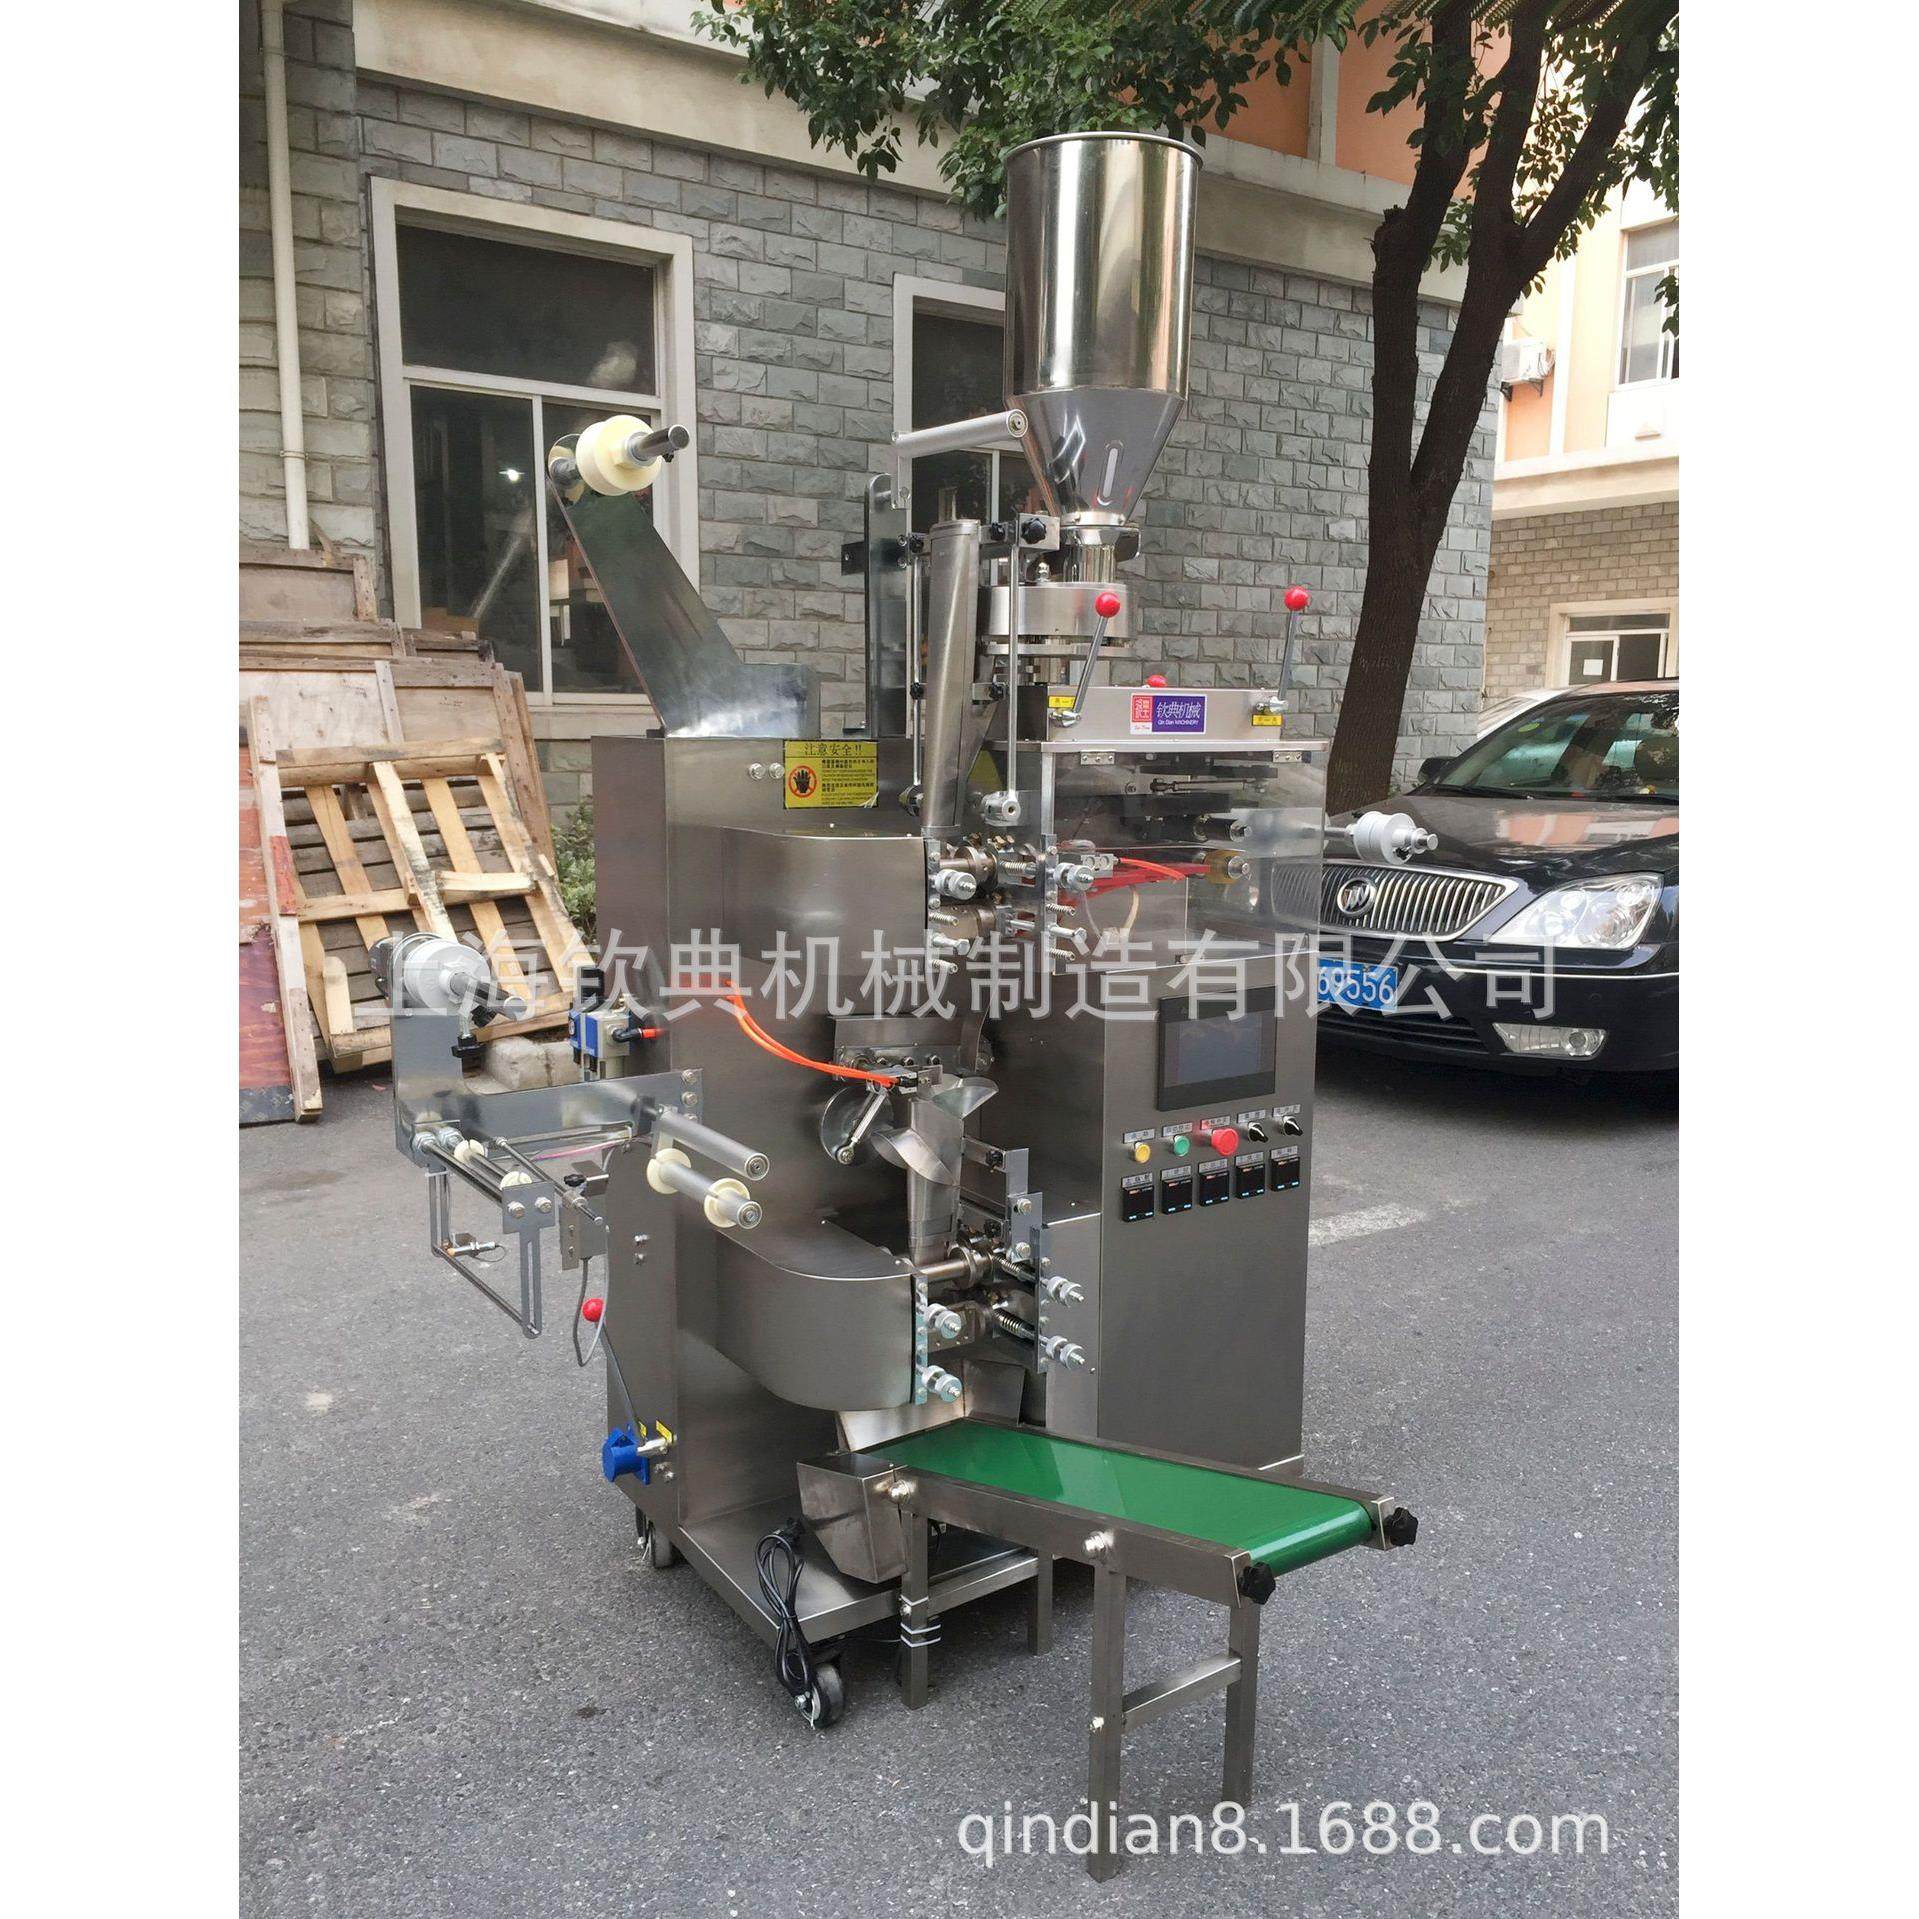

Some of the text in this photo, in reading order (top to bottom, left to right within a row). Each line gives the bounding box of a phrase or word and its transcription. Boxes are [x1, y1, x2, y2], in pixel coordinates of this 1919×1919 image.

[1157, 701, 1201, 718] 钦典机械
[1318, 966, 1394, 1005] 69556
